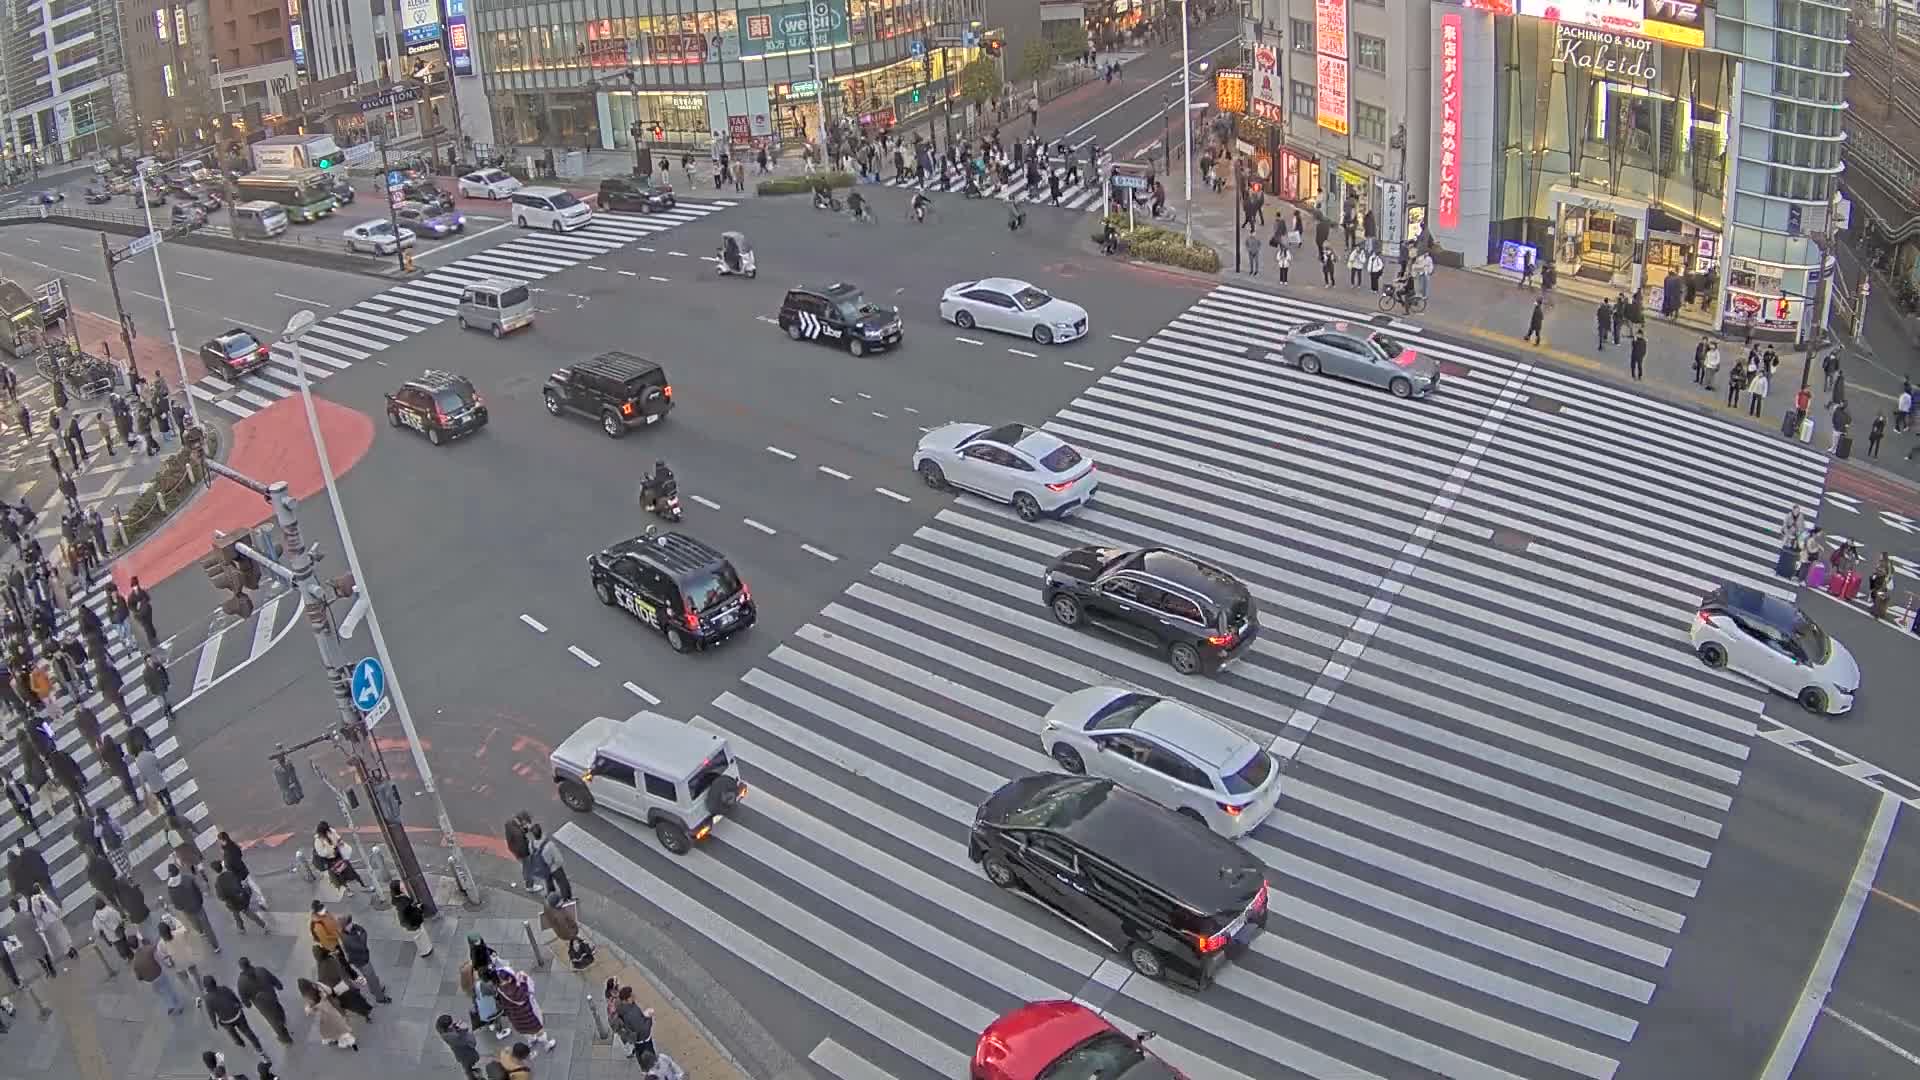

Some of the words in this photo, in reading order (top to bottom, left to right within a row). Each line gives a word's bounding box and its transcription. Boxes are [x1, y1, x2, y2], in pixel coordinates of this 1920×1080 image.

[1556, 26, 1613, 45] PACHINKO
[1614, 36, 1622, 46] &
[1625, 36, 1651, 51] SLOT
[1552, 38, 1657, 80] Kaleido
[822, 325, 843, 338] Uber
